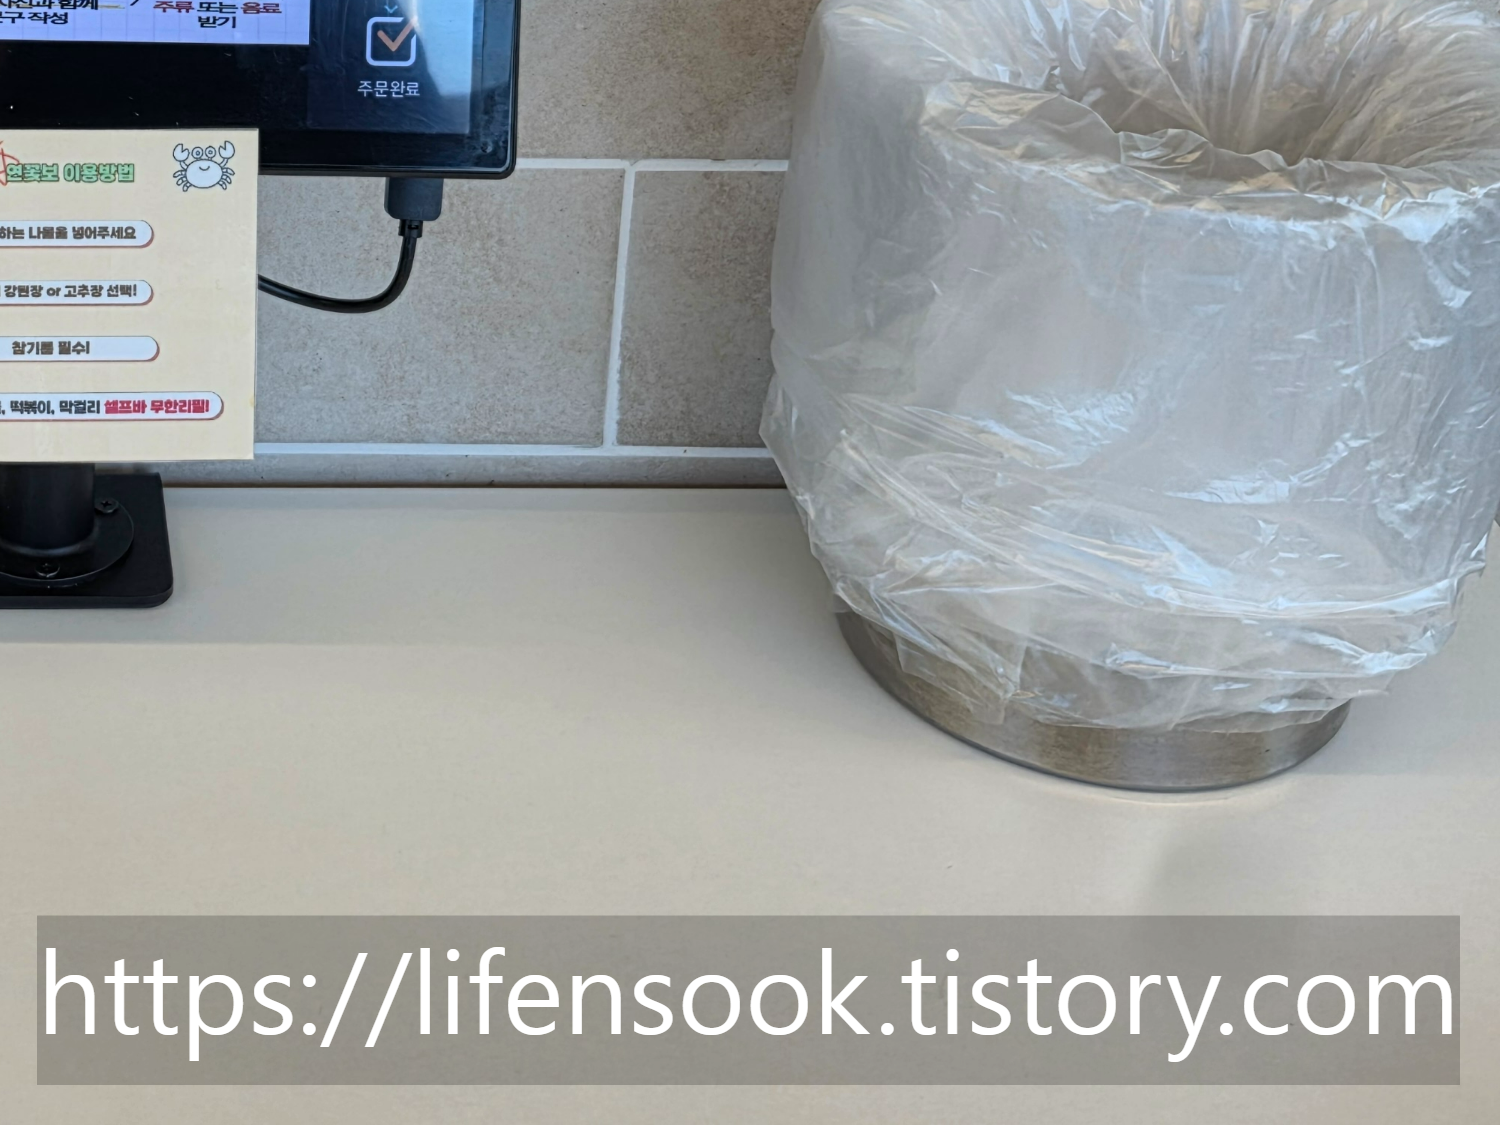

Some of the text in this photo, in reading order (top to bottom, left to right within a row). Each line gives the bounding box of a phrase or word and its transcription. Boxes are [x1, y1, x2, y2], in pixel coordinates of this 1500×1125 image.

[153, 1, 282, 14] 주류 또는 음료
[28, 11, 69, 24] 작성
[198, 15, 236, 28] 받기
[358, 80, 420, 98] 주문완료
[5, 163, 135, 183] 연꽃보 이용방법
[29, 226, 68, 239] 나물을
[4, 285, 43, 297] 강된장
[46, 288, 61, 297] or
[64, 285, 103, 297] 고추장
[107, 284, 137, 297] 선택!
[12, 341, 53, 355] 참기름
[10, 401, 54, 415] 떡볶이,
[59, 400, 100, 414] 막걸리
[104, 400, 146, 414] 셀프바
[150, 399, 209, 414] 무한리필!
